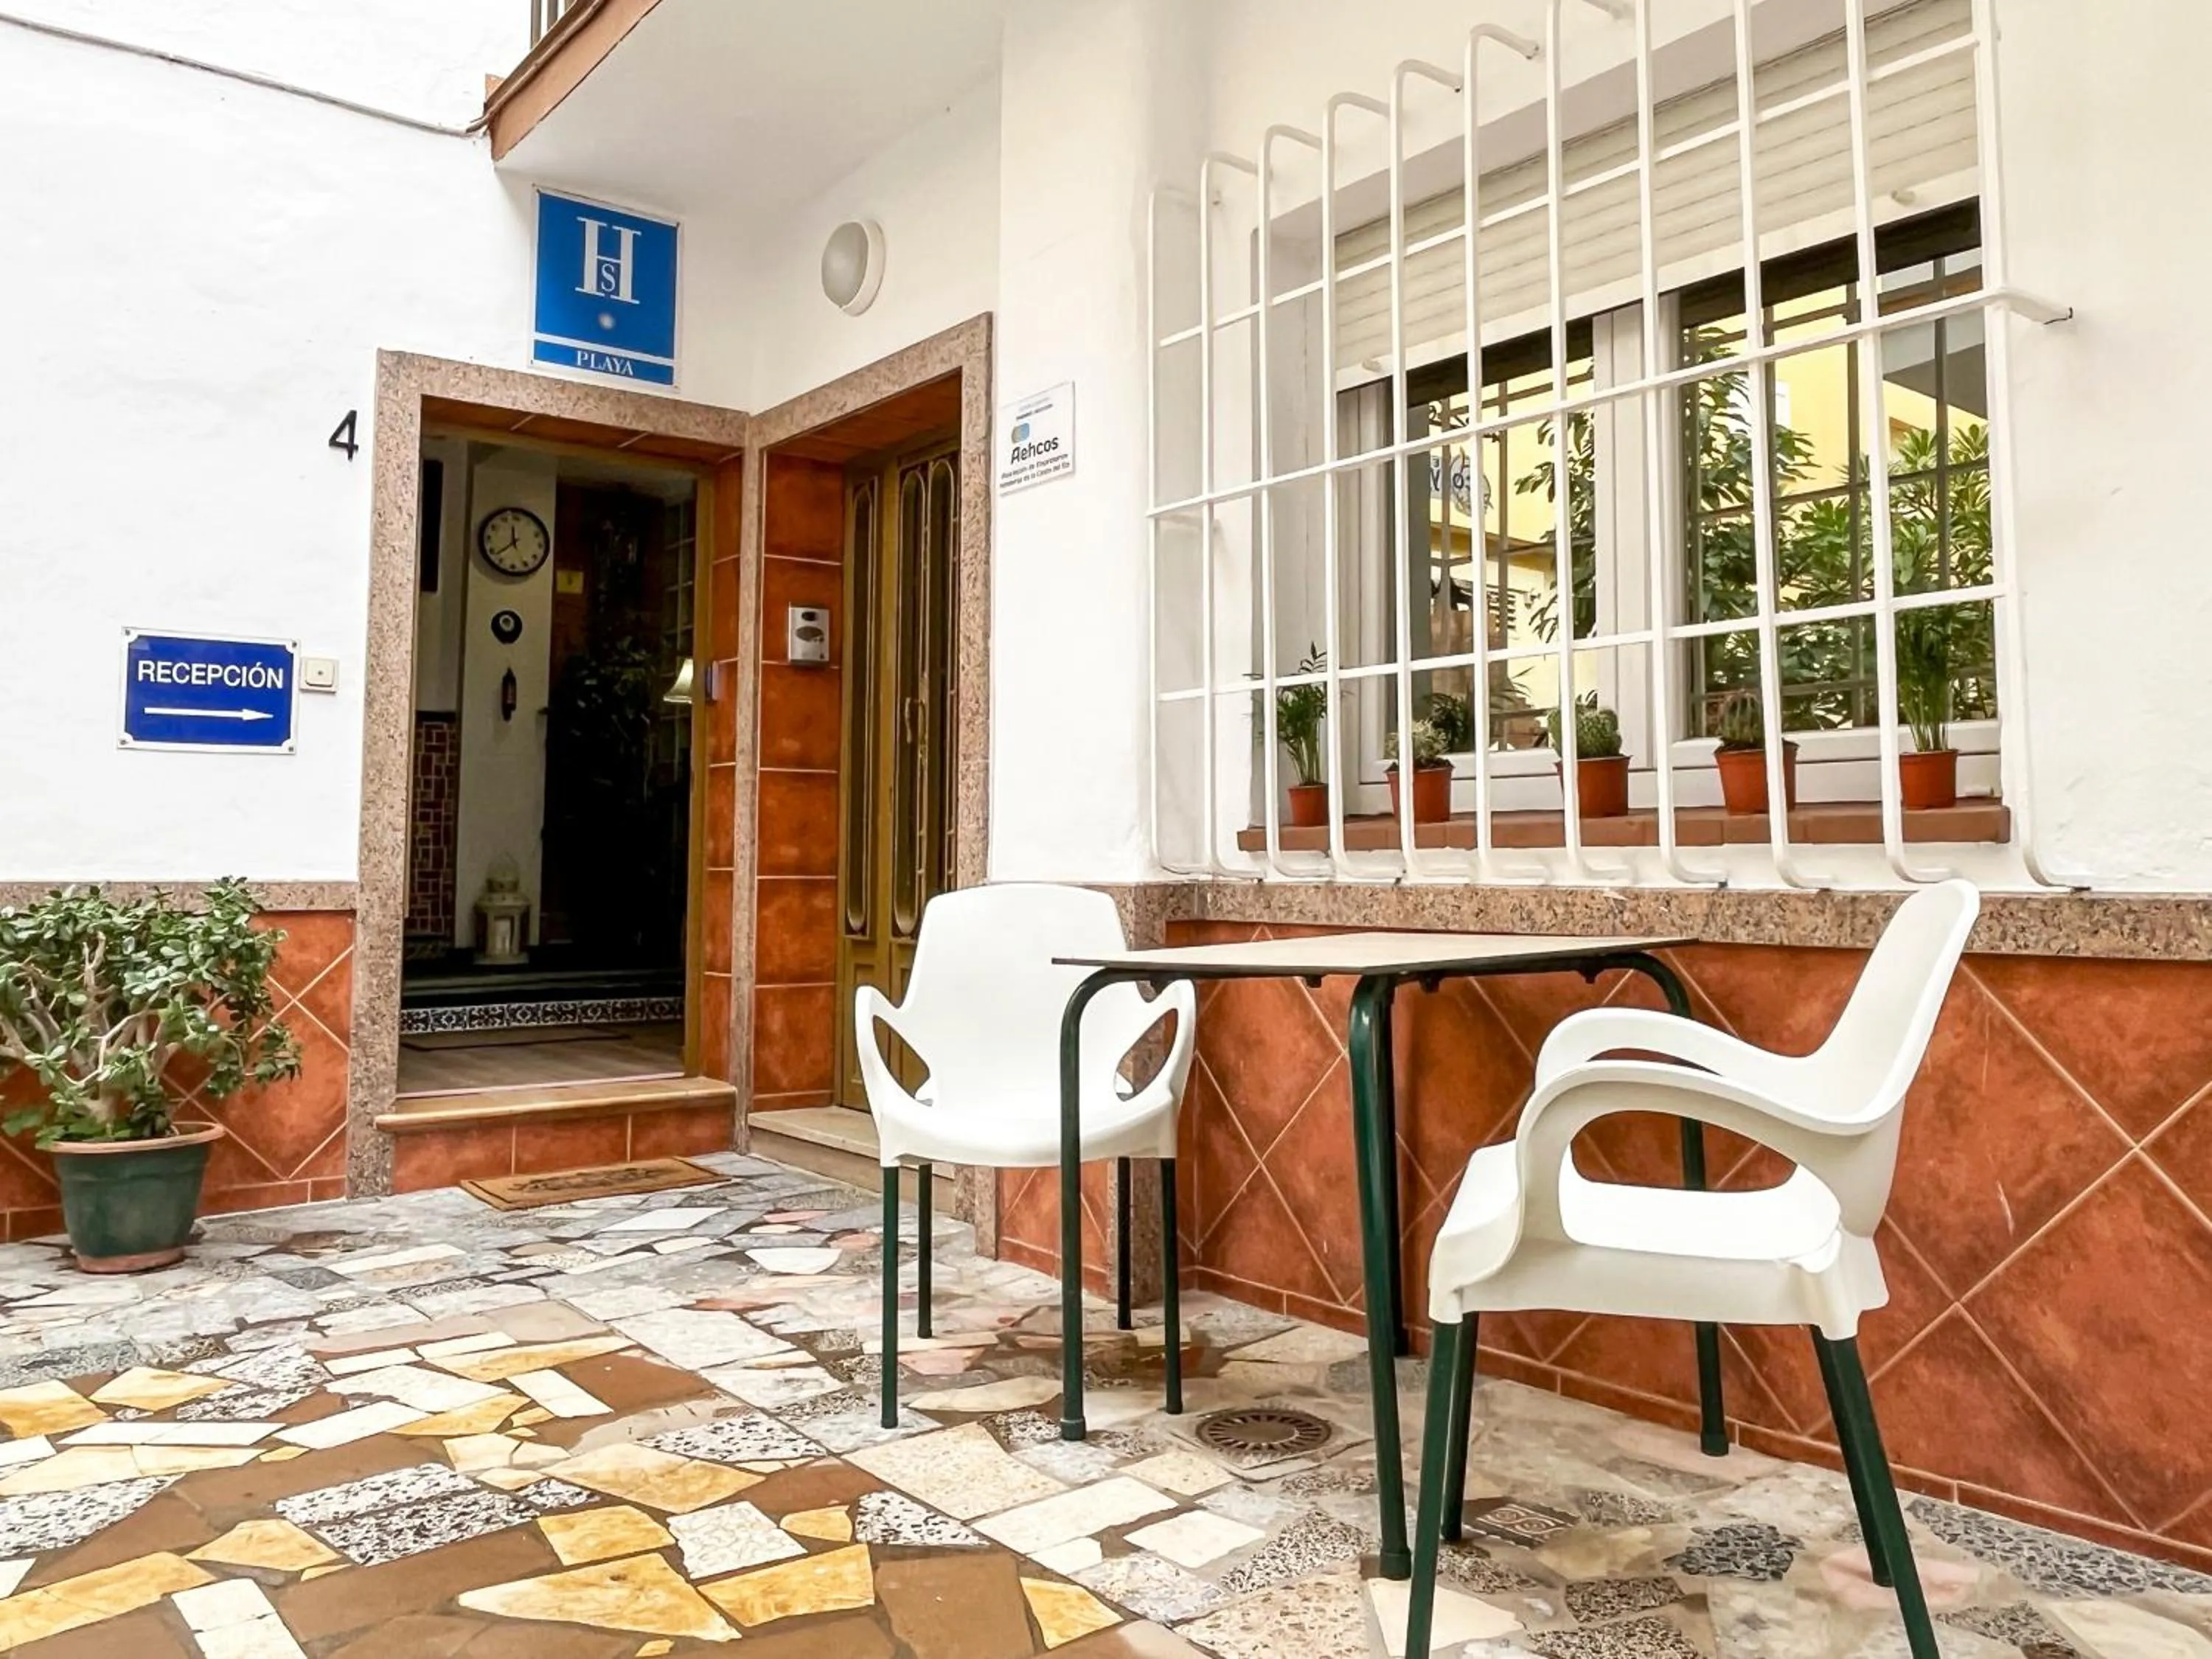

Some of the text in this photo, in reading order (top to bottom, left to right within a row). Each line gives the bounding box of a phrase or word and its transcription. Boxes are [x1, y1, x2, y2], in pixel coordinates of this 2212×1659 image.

[575, 350, 634, 376] PLAYA
[328, 409, 359, 462] 4
[1011, 437, 1059, 465] Aehcos
[138, 661, 284, 689] RECEPCIÓN
